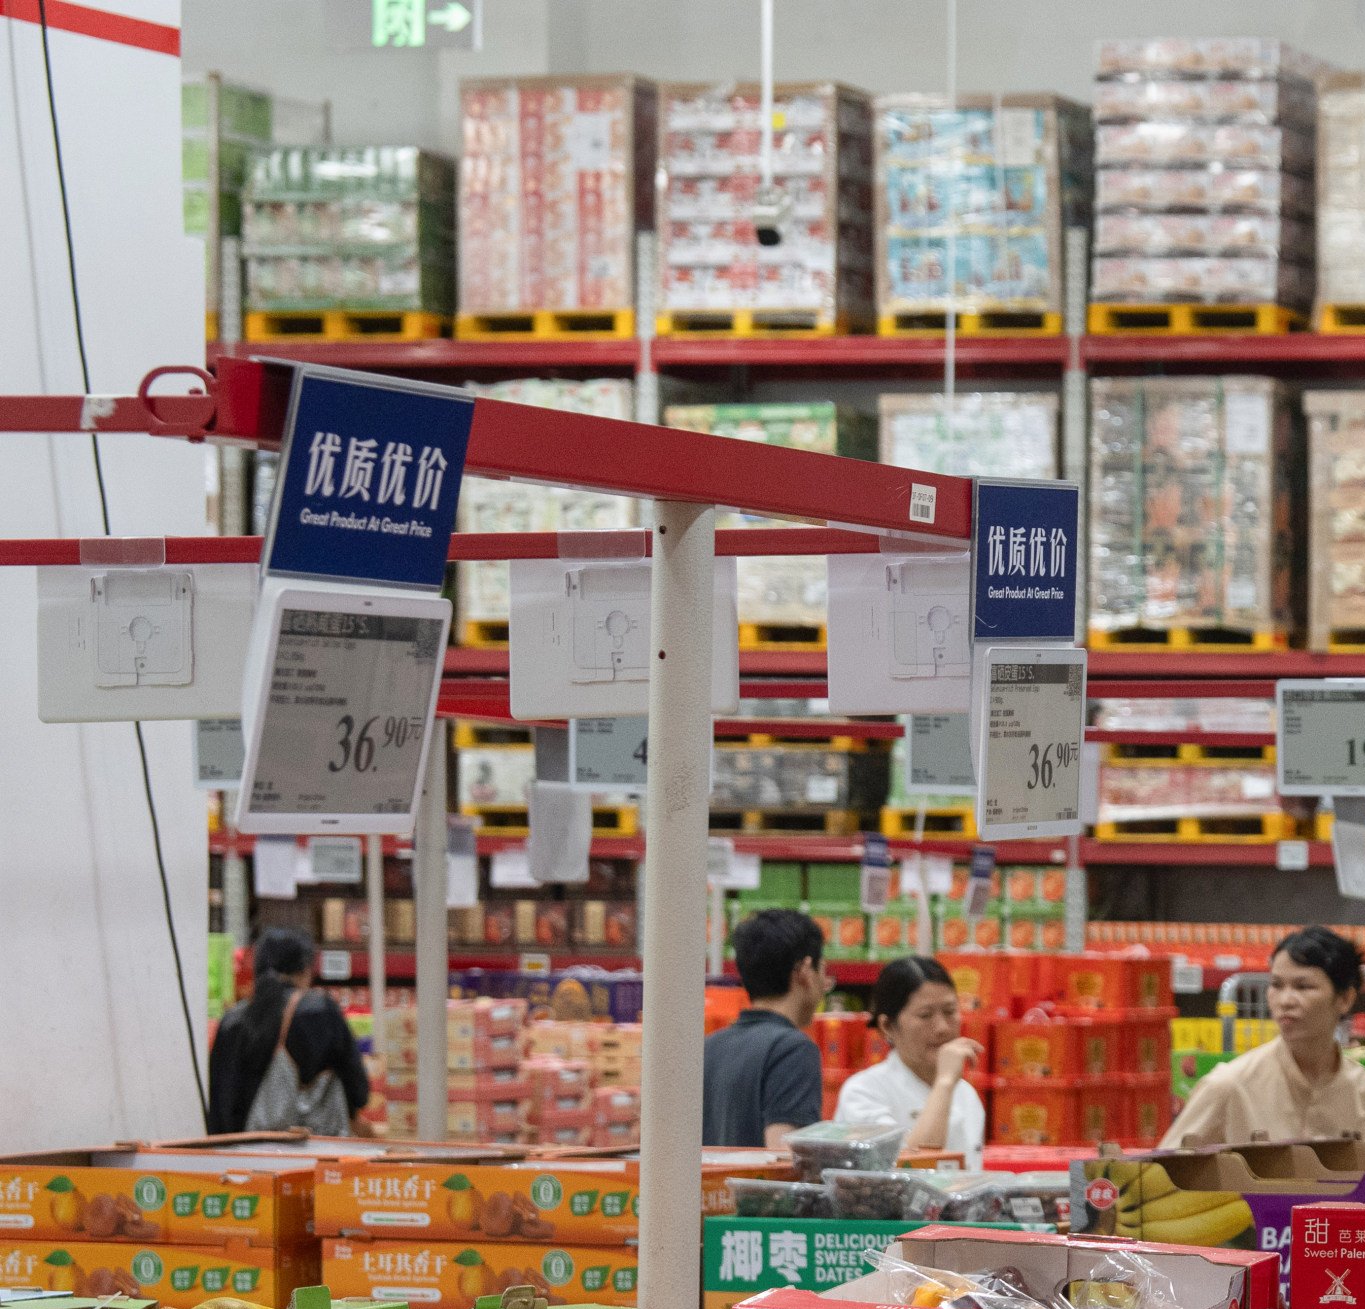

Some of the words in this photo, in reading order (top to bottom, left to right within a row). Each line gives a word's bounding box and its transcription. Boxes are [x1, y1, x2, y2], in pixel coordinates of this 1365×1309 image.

[304, 431, 448, 511] 优质优价
[300, 507, 330, 526] Great
[329, 510, 368, 530] Product
[367, 515, 381, 532] At
[381, 516, 409, 535] Great
[408, 520, 433, 538] Price
[988, 525, 1068, 578] 优质优价
[988, 585, 1004, 599] Great
[1005, 585, 1026, 599] Product
[1027, 587, 1034, 599] At
[1034, 587, 1050, 600] Great
[1051, 587, 1064, 600] Price
[814, 1233, 897, 1250] DELICIOUS
[1304, 1217, 1330, 1245] 甜
[719, 1230, 808, 1282] 椰枣
[814, 1250, 863, 1266] SWEET
[1303, 1247, 1338, 1259] Sweet
[814, 1267, 863, 1283] DATES
